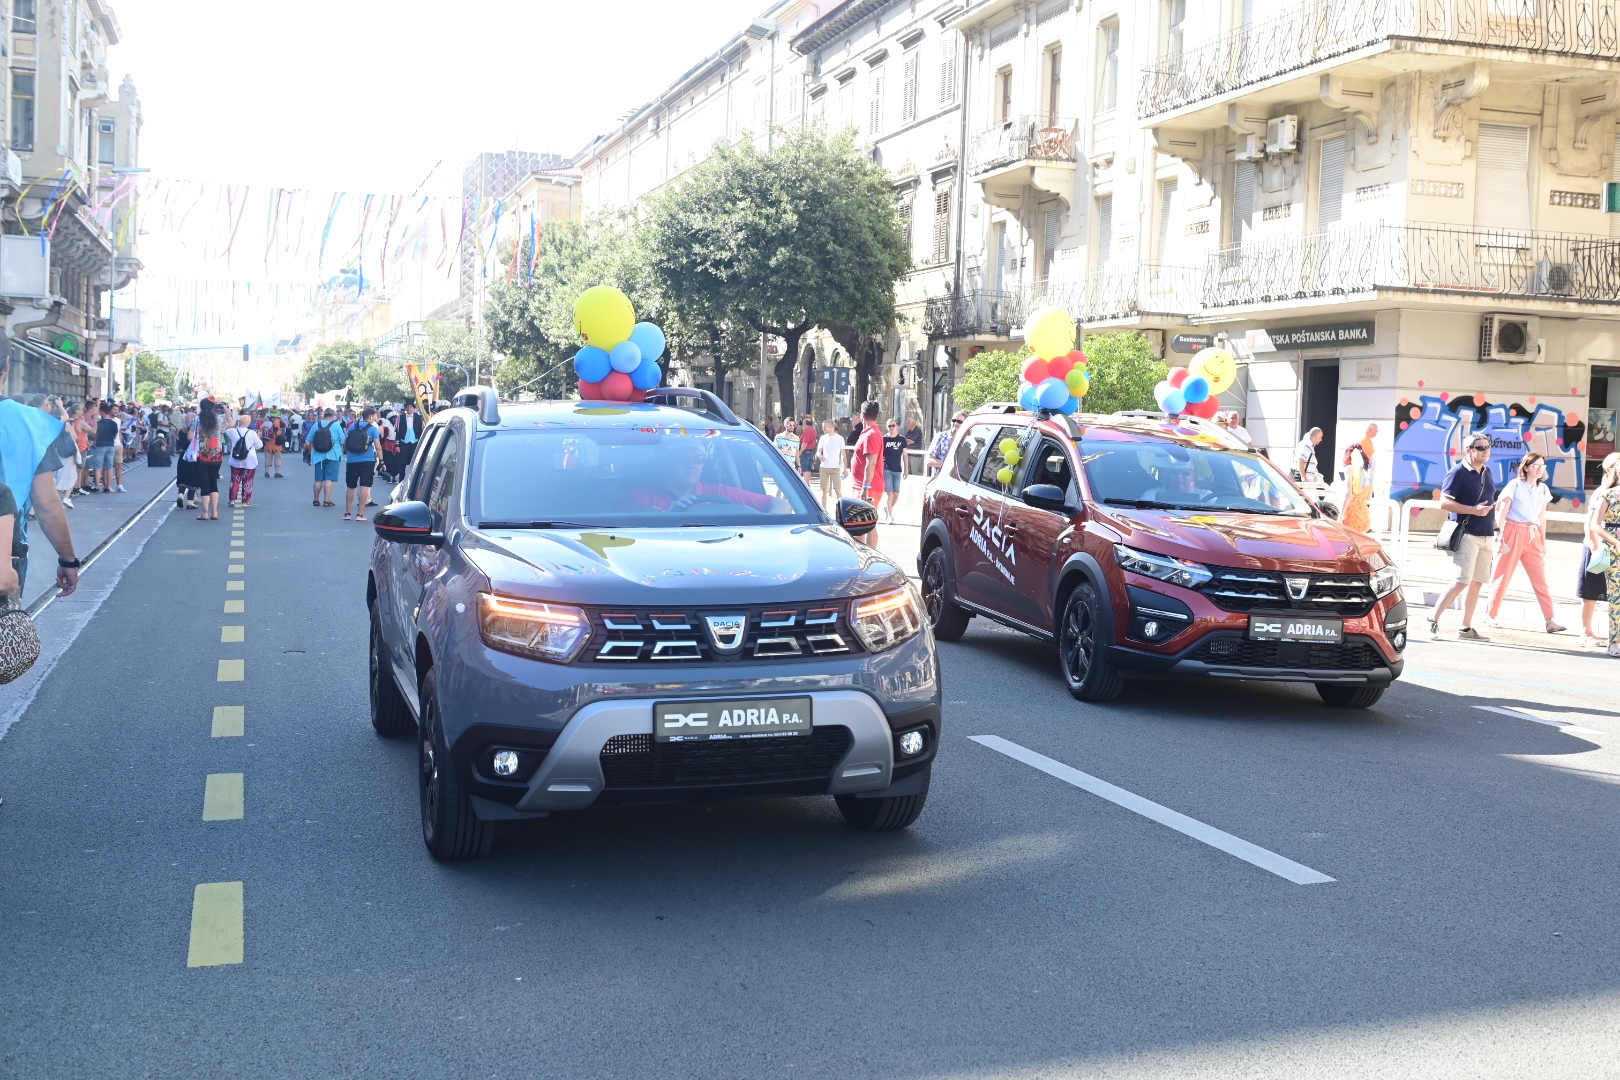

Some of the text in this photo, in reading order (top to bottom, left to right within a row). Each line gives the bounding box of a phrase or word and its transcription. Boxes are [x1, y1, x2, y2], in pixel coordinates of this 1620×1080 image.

[1291, 329, 1337, 344] POŠTANSKA
[1338, 328, 1368, 340] BANKA
[969, 525, 987, 556] ADRIA
[1287, 624, 1323, 635] ADRIA
[718, 708, 780, 727] ADRIA
[782, 713, 803, 724] P.A.
